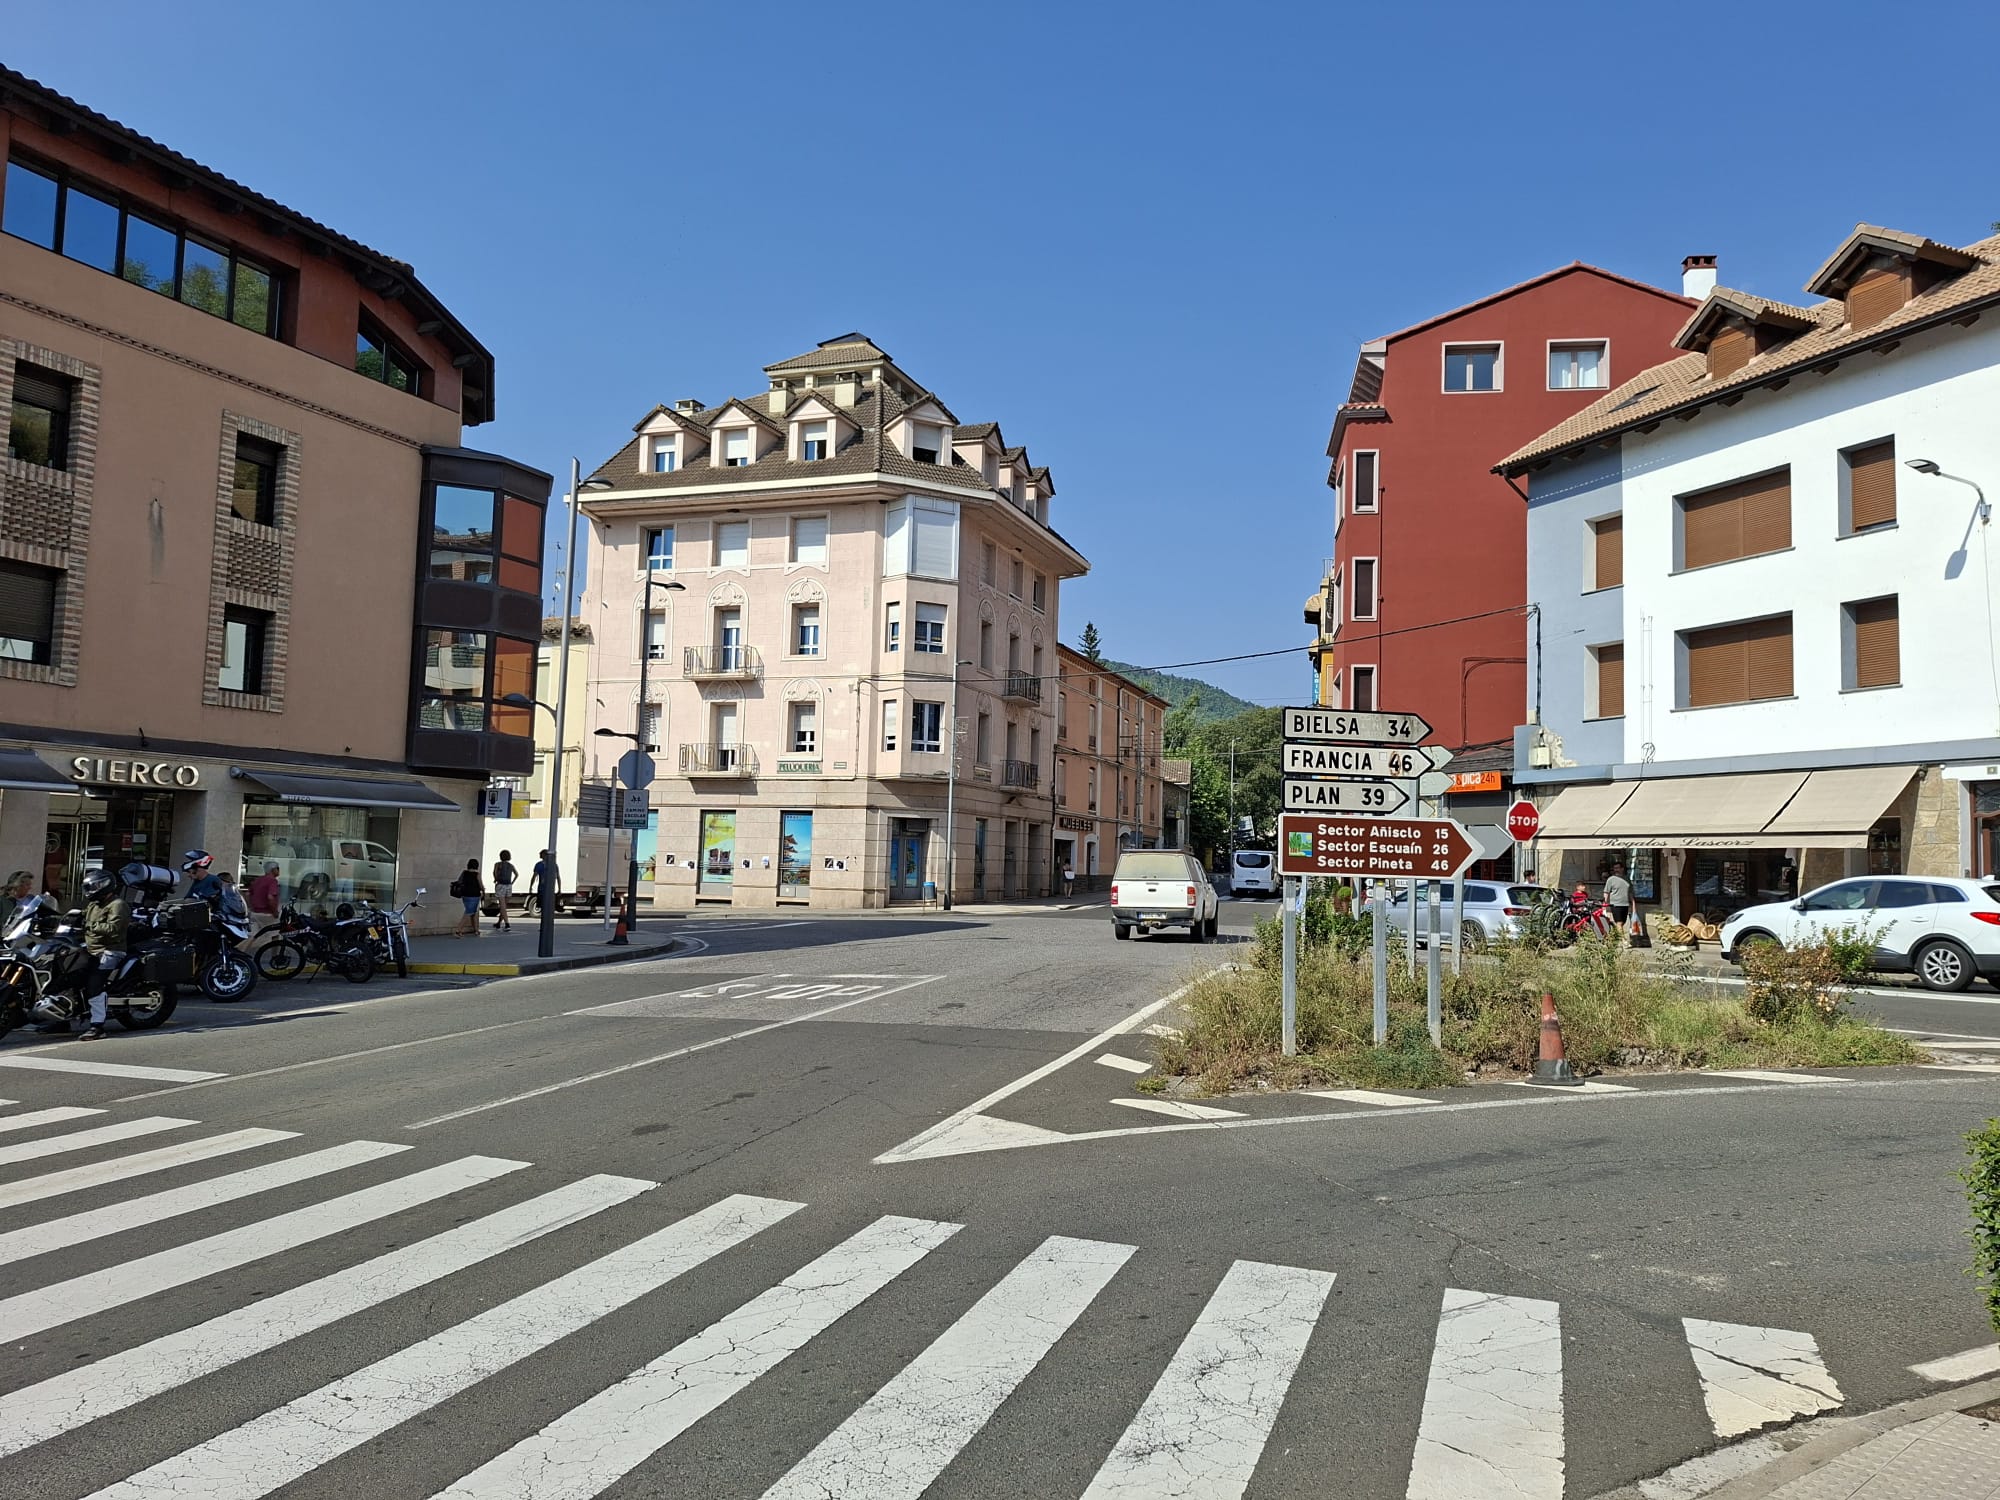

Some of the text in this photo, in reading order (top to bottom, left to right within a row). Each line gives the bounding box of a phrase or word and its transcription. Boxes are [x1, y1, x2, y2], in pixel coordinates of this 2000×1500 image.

[1293, 714, 1411, 738] BIELSA 34
[1291, 750, 1412, 773] FRANCIA 46
[73, 756, 200, 787] SIERCO
[1292, 785, 1385, 806] PLAN 39
[1062, 816, 1092, 831] MUEBLES
[1509, 815, 1538, 827] STOP
[1317, 823, 1449, 840] Sector Añisclo 15
[1317, 839, 1449, 856] Sector Escuaín 26
[1600, 837, 1668, 848] Regalos
[1317, 855, 1449, 871] Sector Pineta 46
